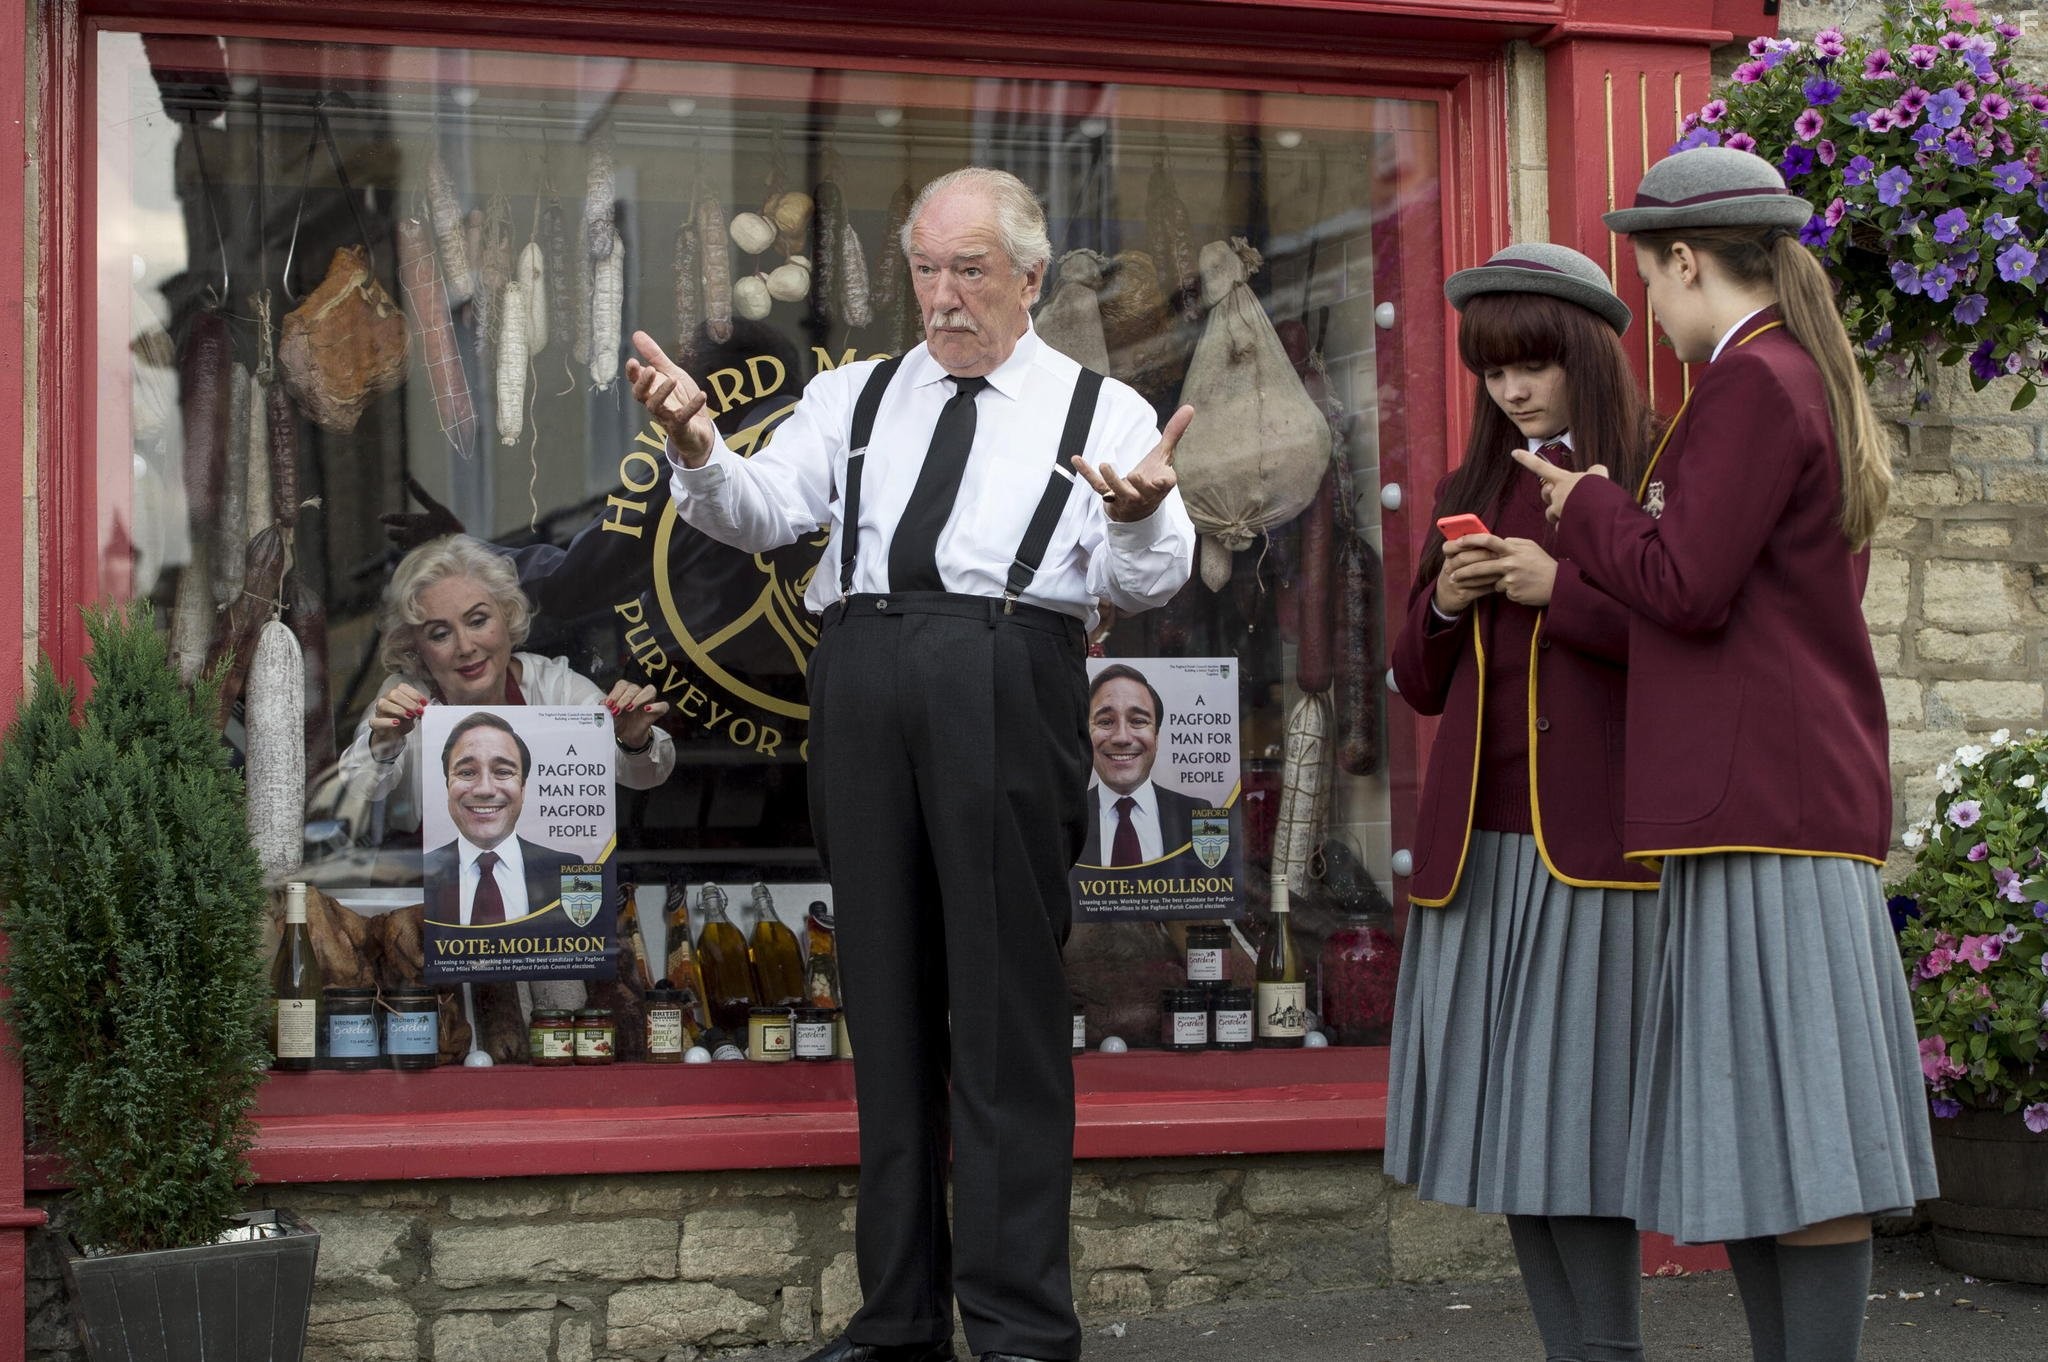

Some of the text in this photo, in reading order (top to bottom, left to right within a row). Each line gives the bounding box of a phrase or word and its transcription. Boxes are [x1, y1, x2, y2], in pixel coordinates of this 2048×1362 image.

[614, 598, 782, 758] PURVEYOR
[1195, 694, 1206, 706] A
[1170, 713, 1232, 725] PAGFORD
[1171, 733, 1232, 745] MAN FOR
[566, 744, 577, 756] A
[1172, 752, 1231, 764] PAGFORD
[537, 764, 606, 776] PAGFORD
[1180, 771, 1224, 783] PEOPLE
[539, 784, 606, 797] MAN FOR
[540, 805, 605, 817] PAGFORD
[1191, 809, 1229, 817] PAGFORD
[549, 825, 597, 837] PEOPLE
[560, 865, 602, 873] PAGFORD
[1078, 877, 1234, 896] VOTE: MOLLISON
[434, 936, 606, 956] VOTE: MOLLISON
